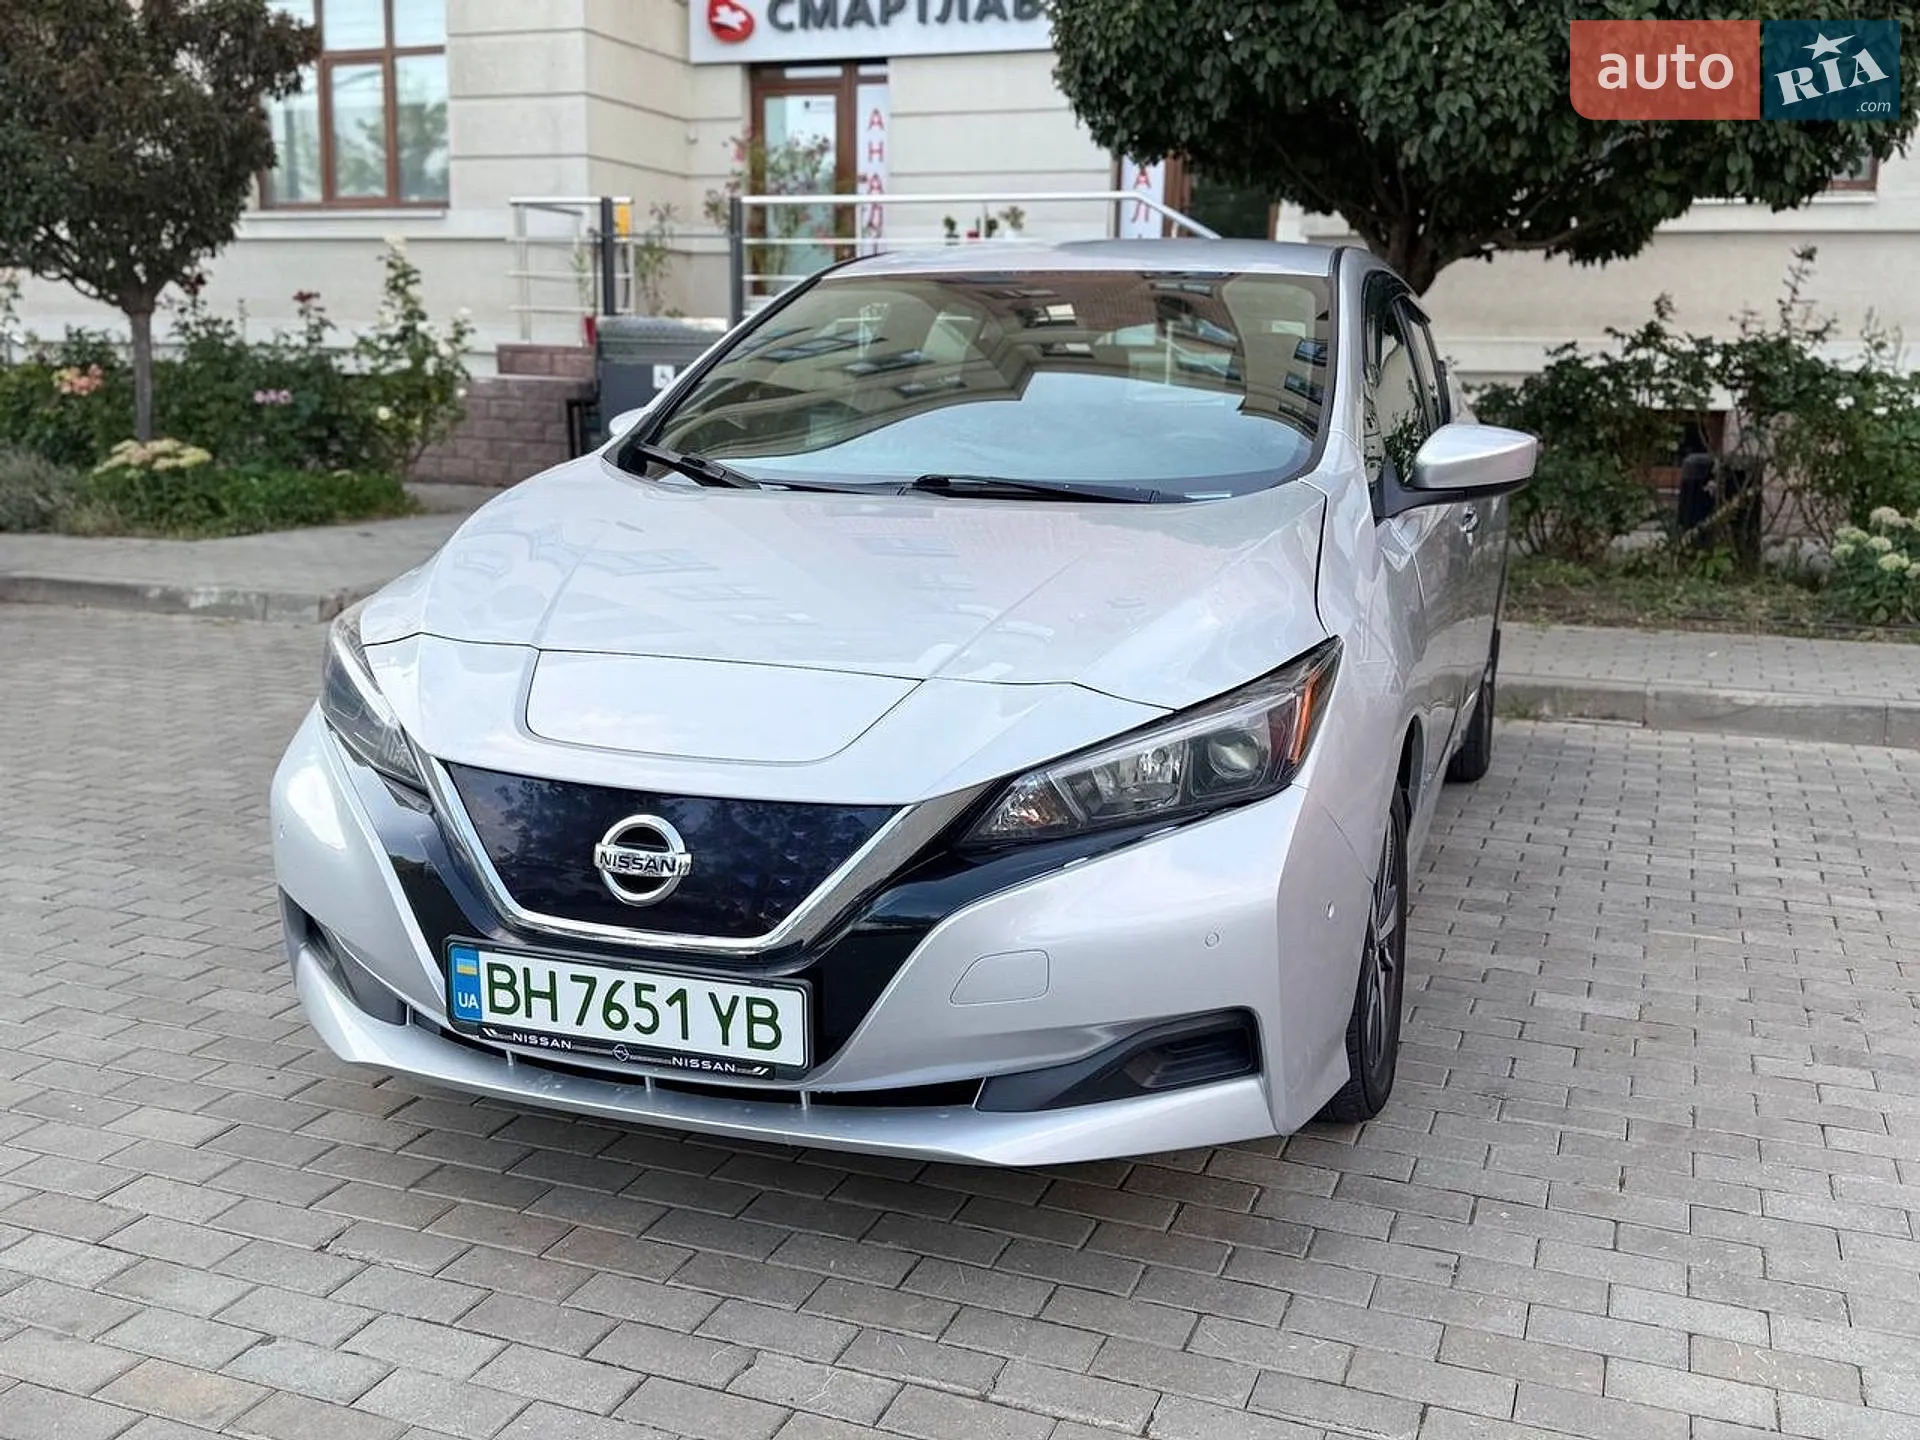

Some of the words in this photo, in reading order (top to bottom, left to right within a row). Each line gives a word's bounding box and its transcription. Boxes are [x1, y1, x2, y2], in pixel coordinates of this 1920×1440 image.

[600, 850, 677, 873] NISSAN
[458, 991, 480, 1009] UA
[486, 962, 558, 1022] BH
[570, 973, 689, 1041] 7651
[708, 991, 783, 1051] YB
[511, 1032, 573, 1050] NISSAN
[671, 1056, 736, 1073] NISSAN
